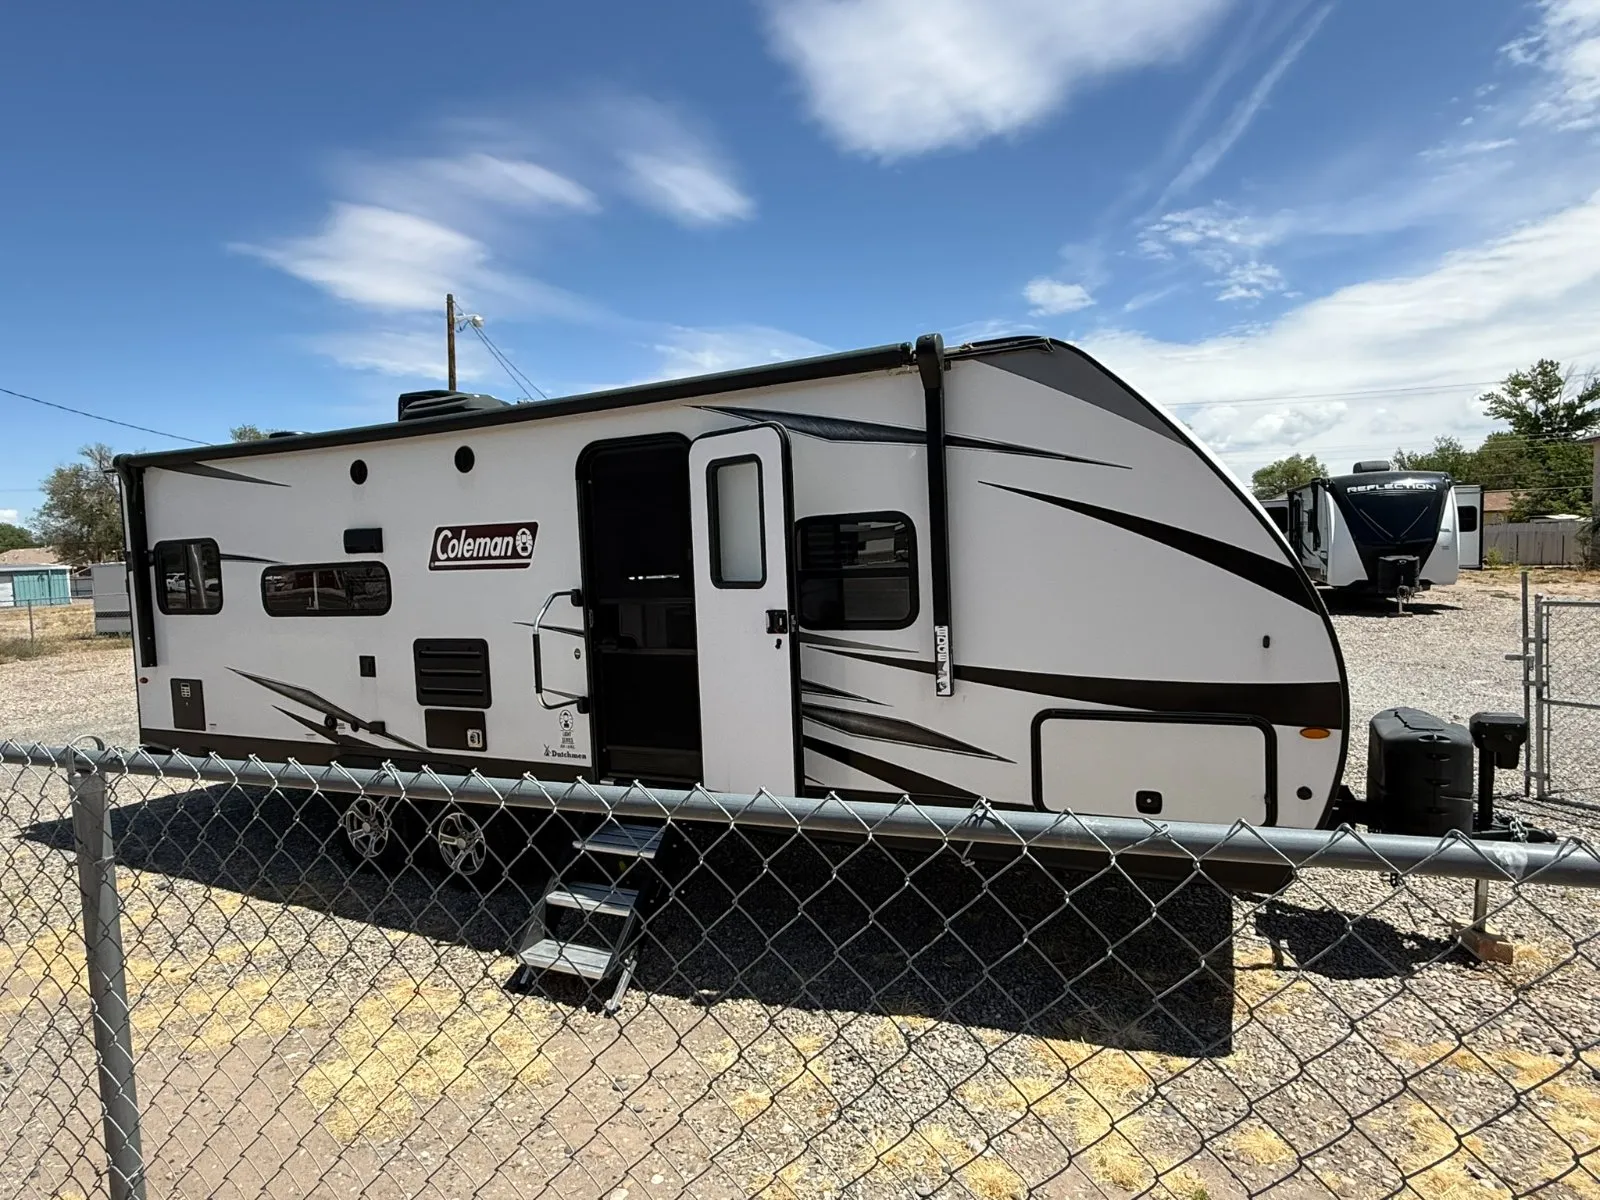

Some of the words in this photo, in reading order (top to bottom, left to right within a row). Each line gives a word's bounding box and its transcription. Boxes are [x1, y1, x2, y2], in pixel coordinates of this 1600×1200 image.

[1346, 483, 1437, 493] REFLECTION
[436, 529, 514, 560] Coleman
[551, 750, 587, 760] Dutchmen
